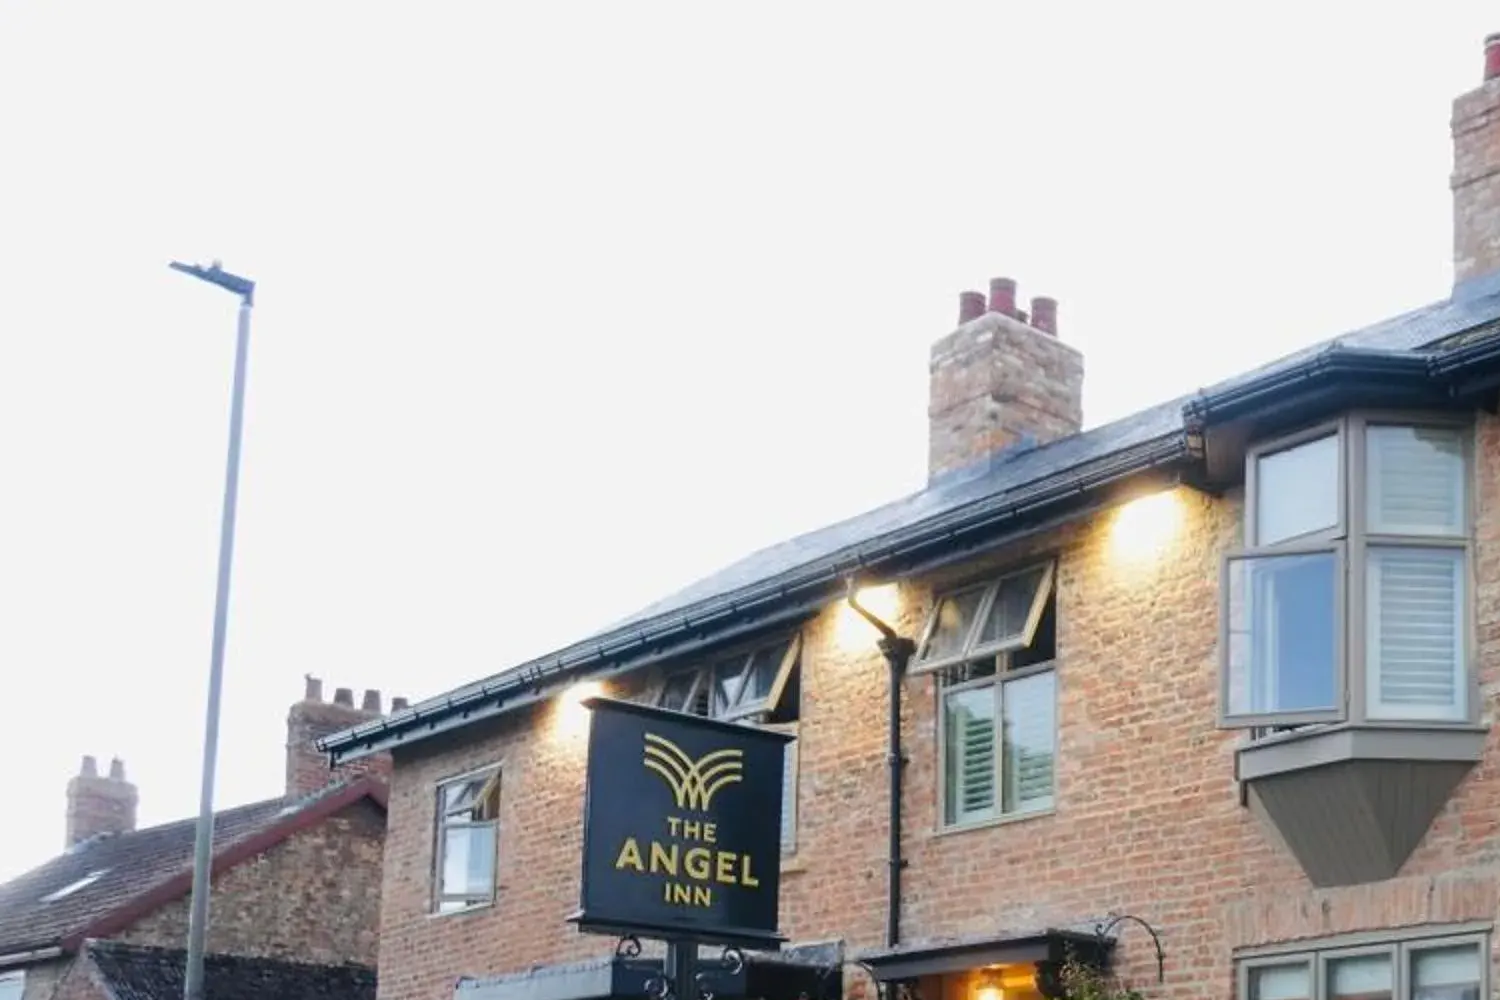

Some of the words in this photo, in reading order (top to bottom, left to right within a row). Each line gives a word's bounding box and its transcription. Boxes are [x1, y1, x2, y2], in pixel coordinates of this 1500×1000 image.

[668, 817, 717, 843] THE
[615, 837, 760, 887] ANGEL
[664, 882, 712, 907] INN
